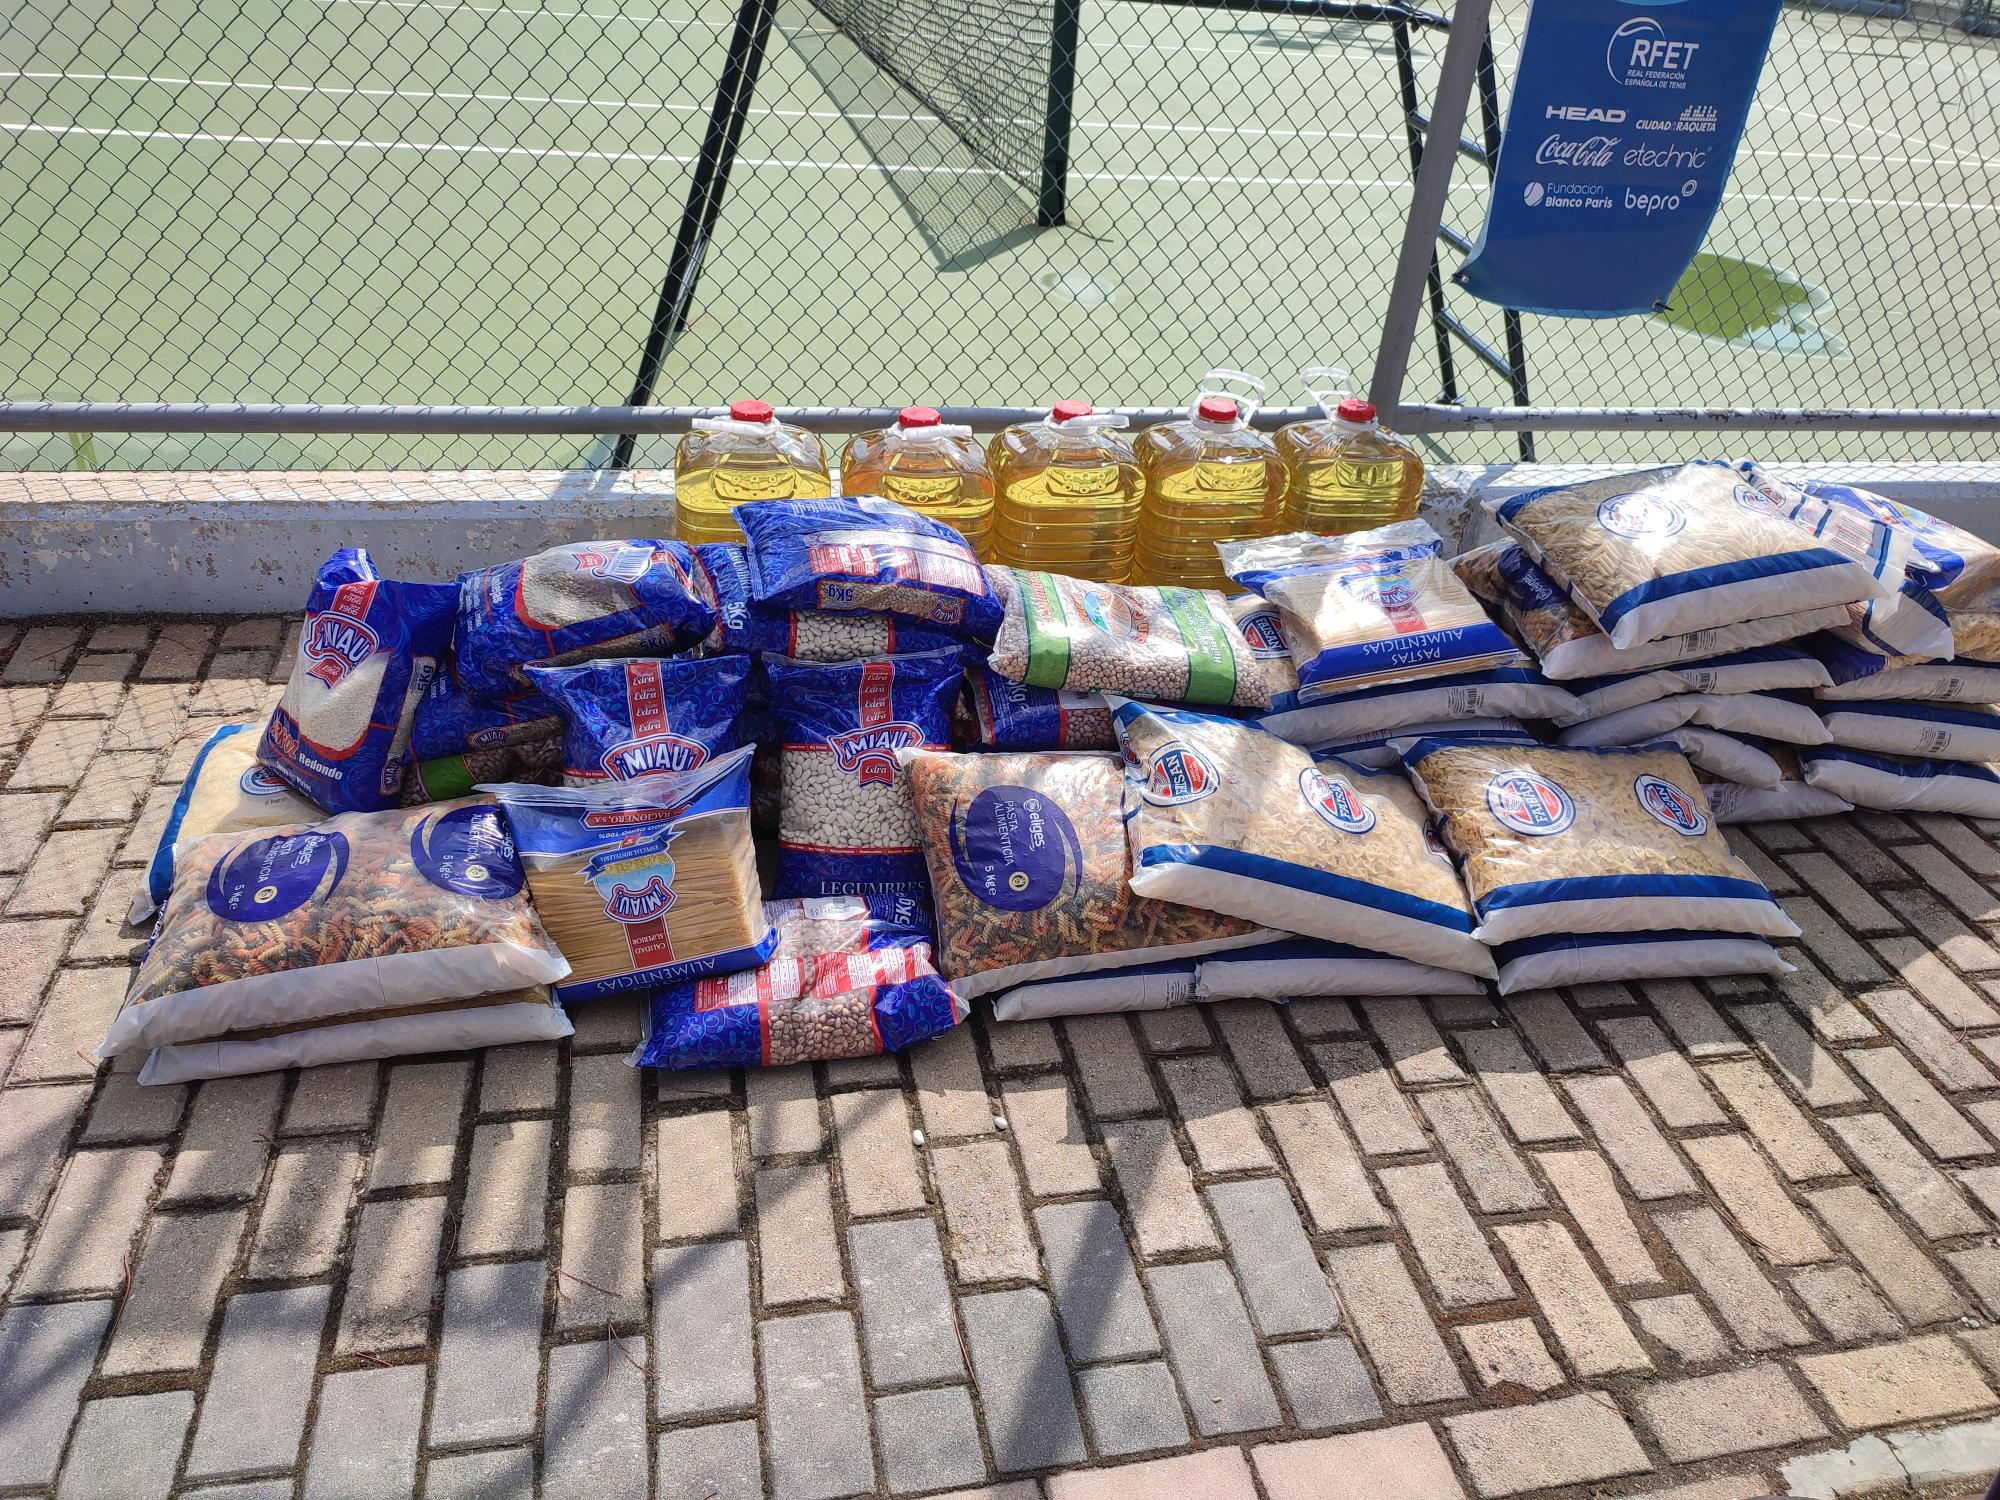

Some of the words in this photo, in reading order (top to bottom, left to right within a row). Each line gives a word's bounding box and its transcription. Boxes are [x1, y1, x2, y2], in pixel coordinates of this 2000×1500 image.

[1630, 38, 1699, 70] RFET
[1626, 69, 1644, 78] REAL
[1644, 70, 1686, 80] FEDERACIÓN
[1624, 78, 1658, 88] ESPAÑOLA
[1658, 81, 1668, 89] DE
[1668, 82, 1687, 90] TENIS
[1546, 105, 1627, 124] HEAD
[1635, 119, 1672, 132] CIUDAD
[1676, 121, 1716, 133] RAQUETA
[1623, 142, 1707, 168] etechnic
[1547, 181, 1604, 195] Fundación
[1545, 196, 1583, 208] Blanco
[1624, 186, 1681, 216] bepro
[342, 594, 364, 606] 1966
[827, 583, 854, 602] 5Kg
[338, 604, 359, 616] 1966
[727, 600, 748, 631] 5Kg
[1255, 615, 1283, 651] FAISAN
[639, 635, 668, 652] 5Kg
[1363, 628, 1463, 656] ALIMENTICIAS
[1392, 646, 1441, 666] PASTAS
[321, 664, 339, 676] 1966
[417, 664, 434, 692] 5Kg
[632, 675, 656, 686] Extra
[634, 690, 657, 701] Extra
[864, 699, 886, 708] Extra
[636, 706, 659, 717] Extra
[865, 711, 887, 723] Extra
[638, 721, 662, 732] Extra
[299, 752, 343, 782] Redondo
[865, 764, 887, 774] Extra
[1515, 779, 1548, 823] FAISAN
[1656, 786, 1688, 826] FAISAN
[1004, 800, 1019, 832] PASTA
[993, 802, 1015, 867] ALIMENTICIA
[1028, 811, 1046, 850] eliges
[634, 844, 659, 856] ESPECIAL
[820, 881, 928, 896] LEGUMBRES
[894, 894, 916, 927] 5Kg
[631, 931, 664, 945] SUPERIOR
[634, 942, 666, 954] CALIDAD
[596, 957, 716, 993] ALIMENTICIAS
